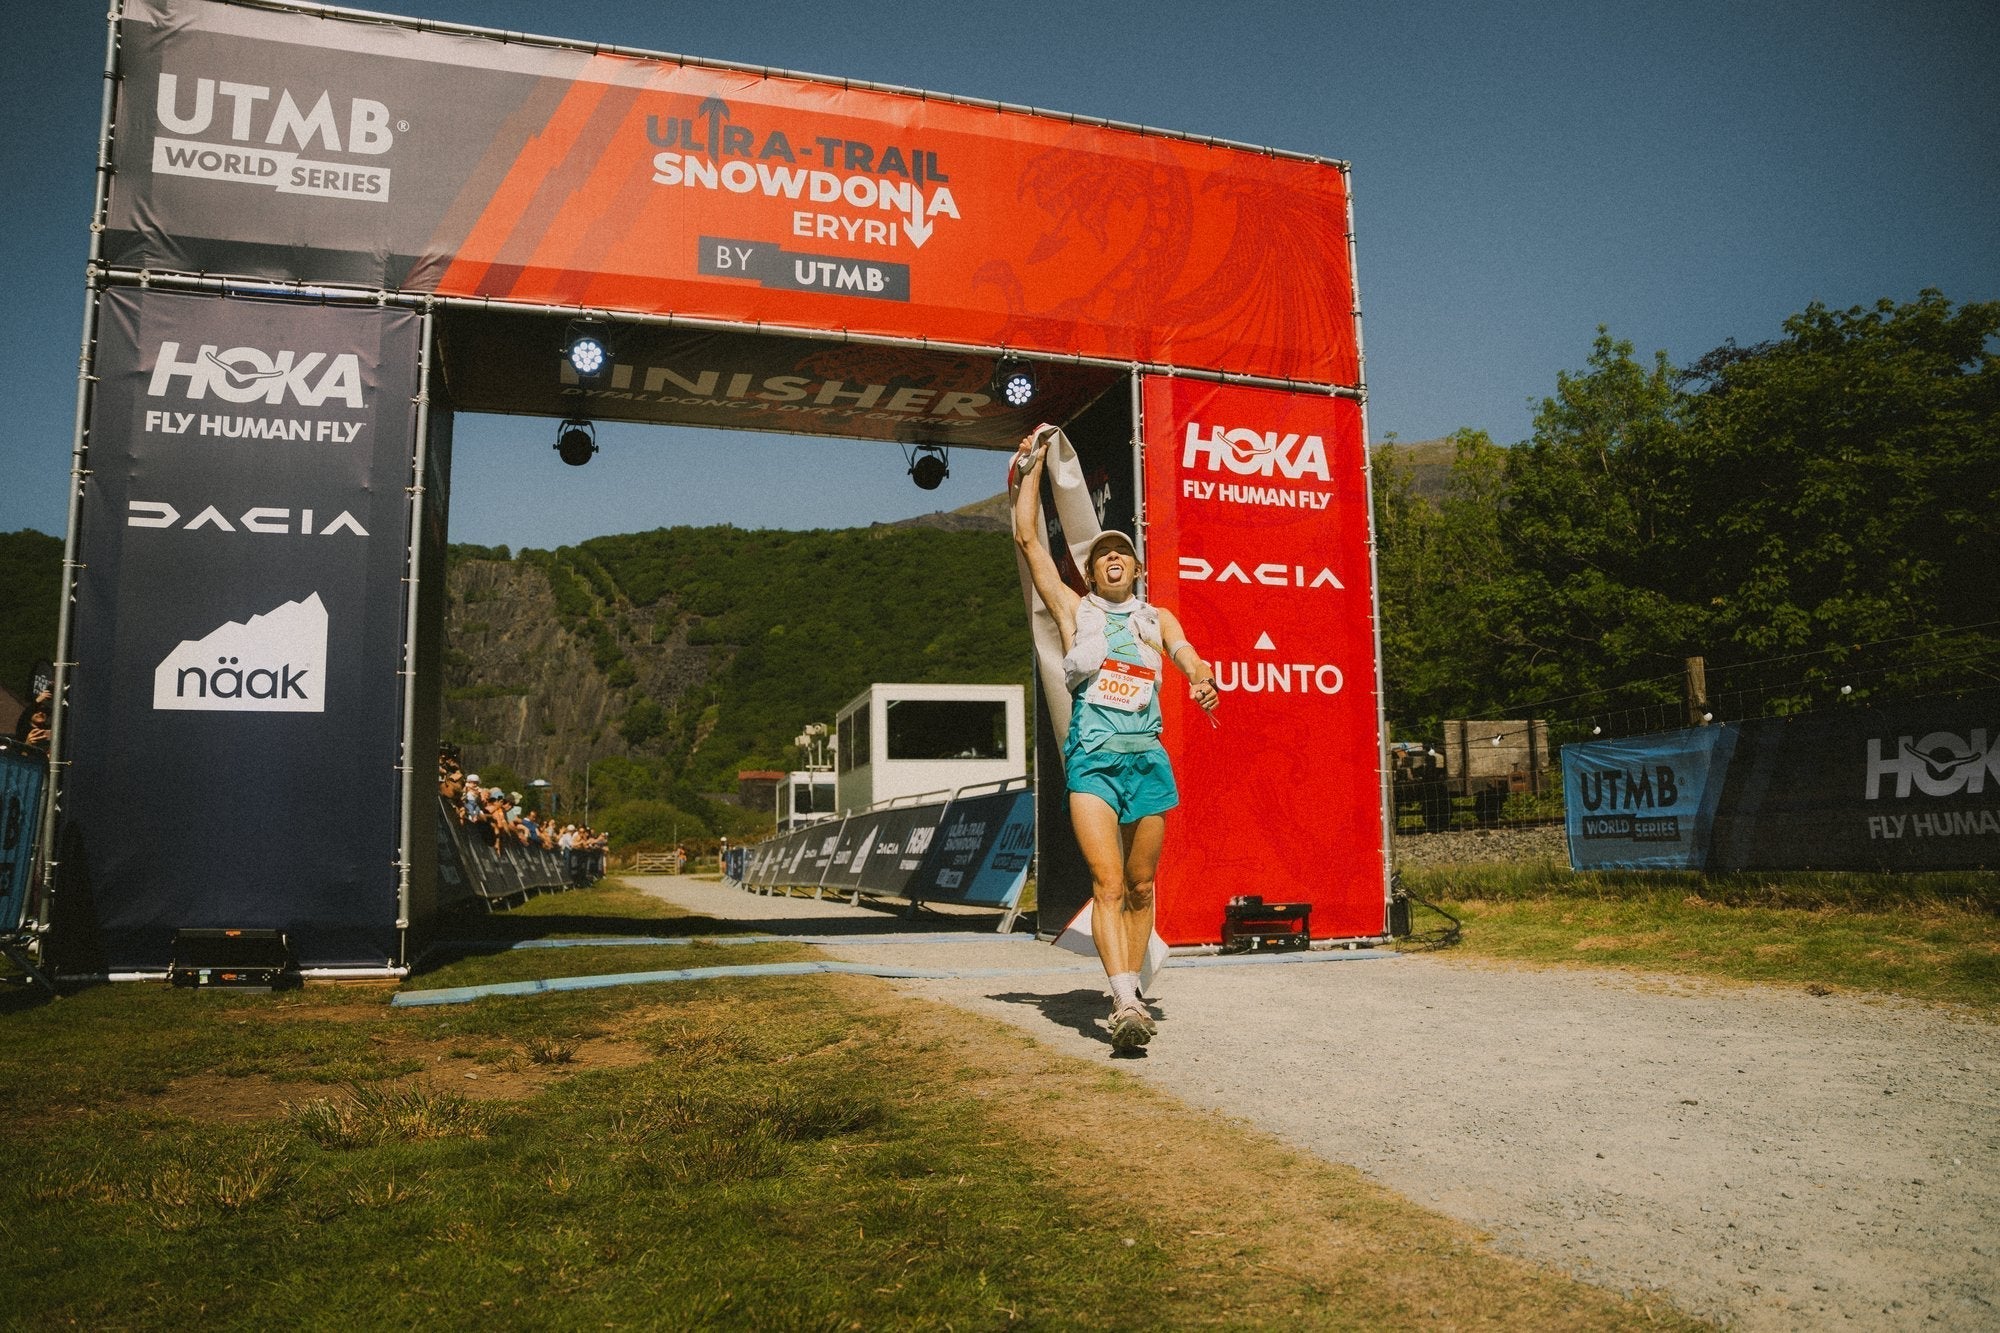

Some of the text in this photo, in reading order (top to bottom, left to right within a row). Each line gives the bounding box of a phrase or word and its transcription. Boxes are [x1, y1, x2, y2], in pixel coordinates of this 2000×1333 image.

[646, 92, 950, 188] ULTRA-TRAIL
[165, 146, 381, 194] WORLD SERIES
[652, 152, 961, 248] SNOWDONIA
[793, 211, 897, 246] ERYRI
[716, 245, 753, 270] BY
[148, 341, 364, 408] HOKA
[145, 410, 364, 443] FLY HUMAN FLY
[1182, 422, 1332, 482] HOKA
[1183, 479, 1333, 510] FLY HUMAN FLY
[128, 500, 370, 536] DACIA
[1178, 556, 1345, 589] DACIA
[177, 656, 309, 700] näak
[1098, 678, 1140, 697] 3007
[1200, 661, 1343, 694] UUNTO
[1103, 694, 1130, 704] ELEANOR
[1586, 820, 1677, 838] WORLD SERIES
[1868, 809, 2000, 839] FLY HUMA
